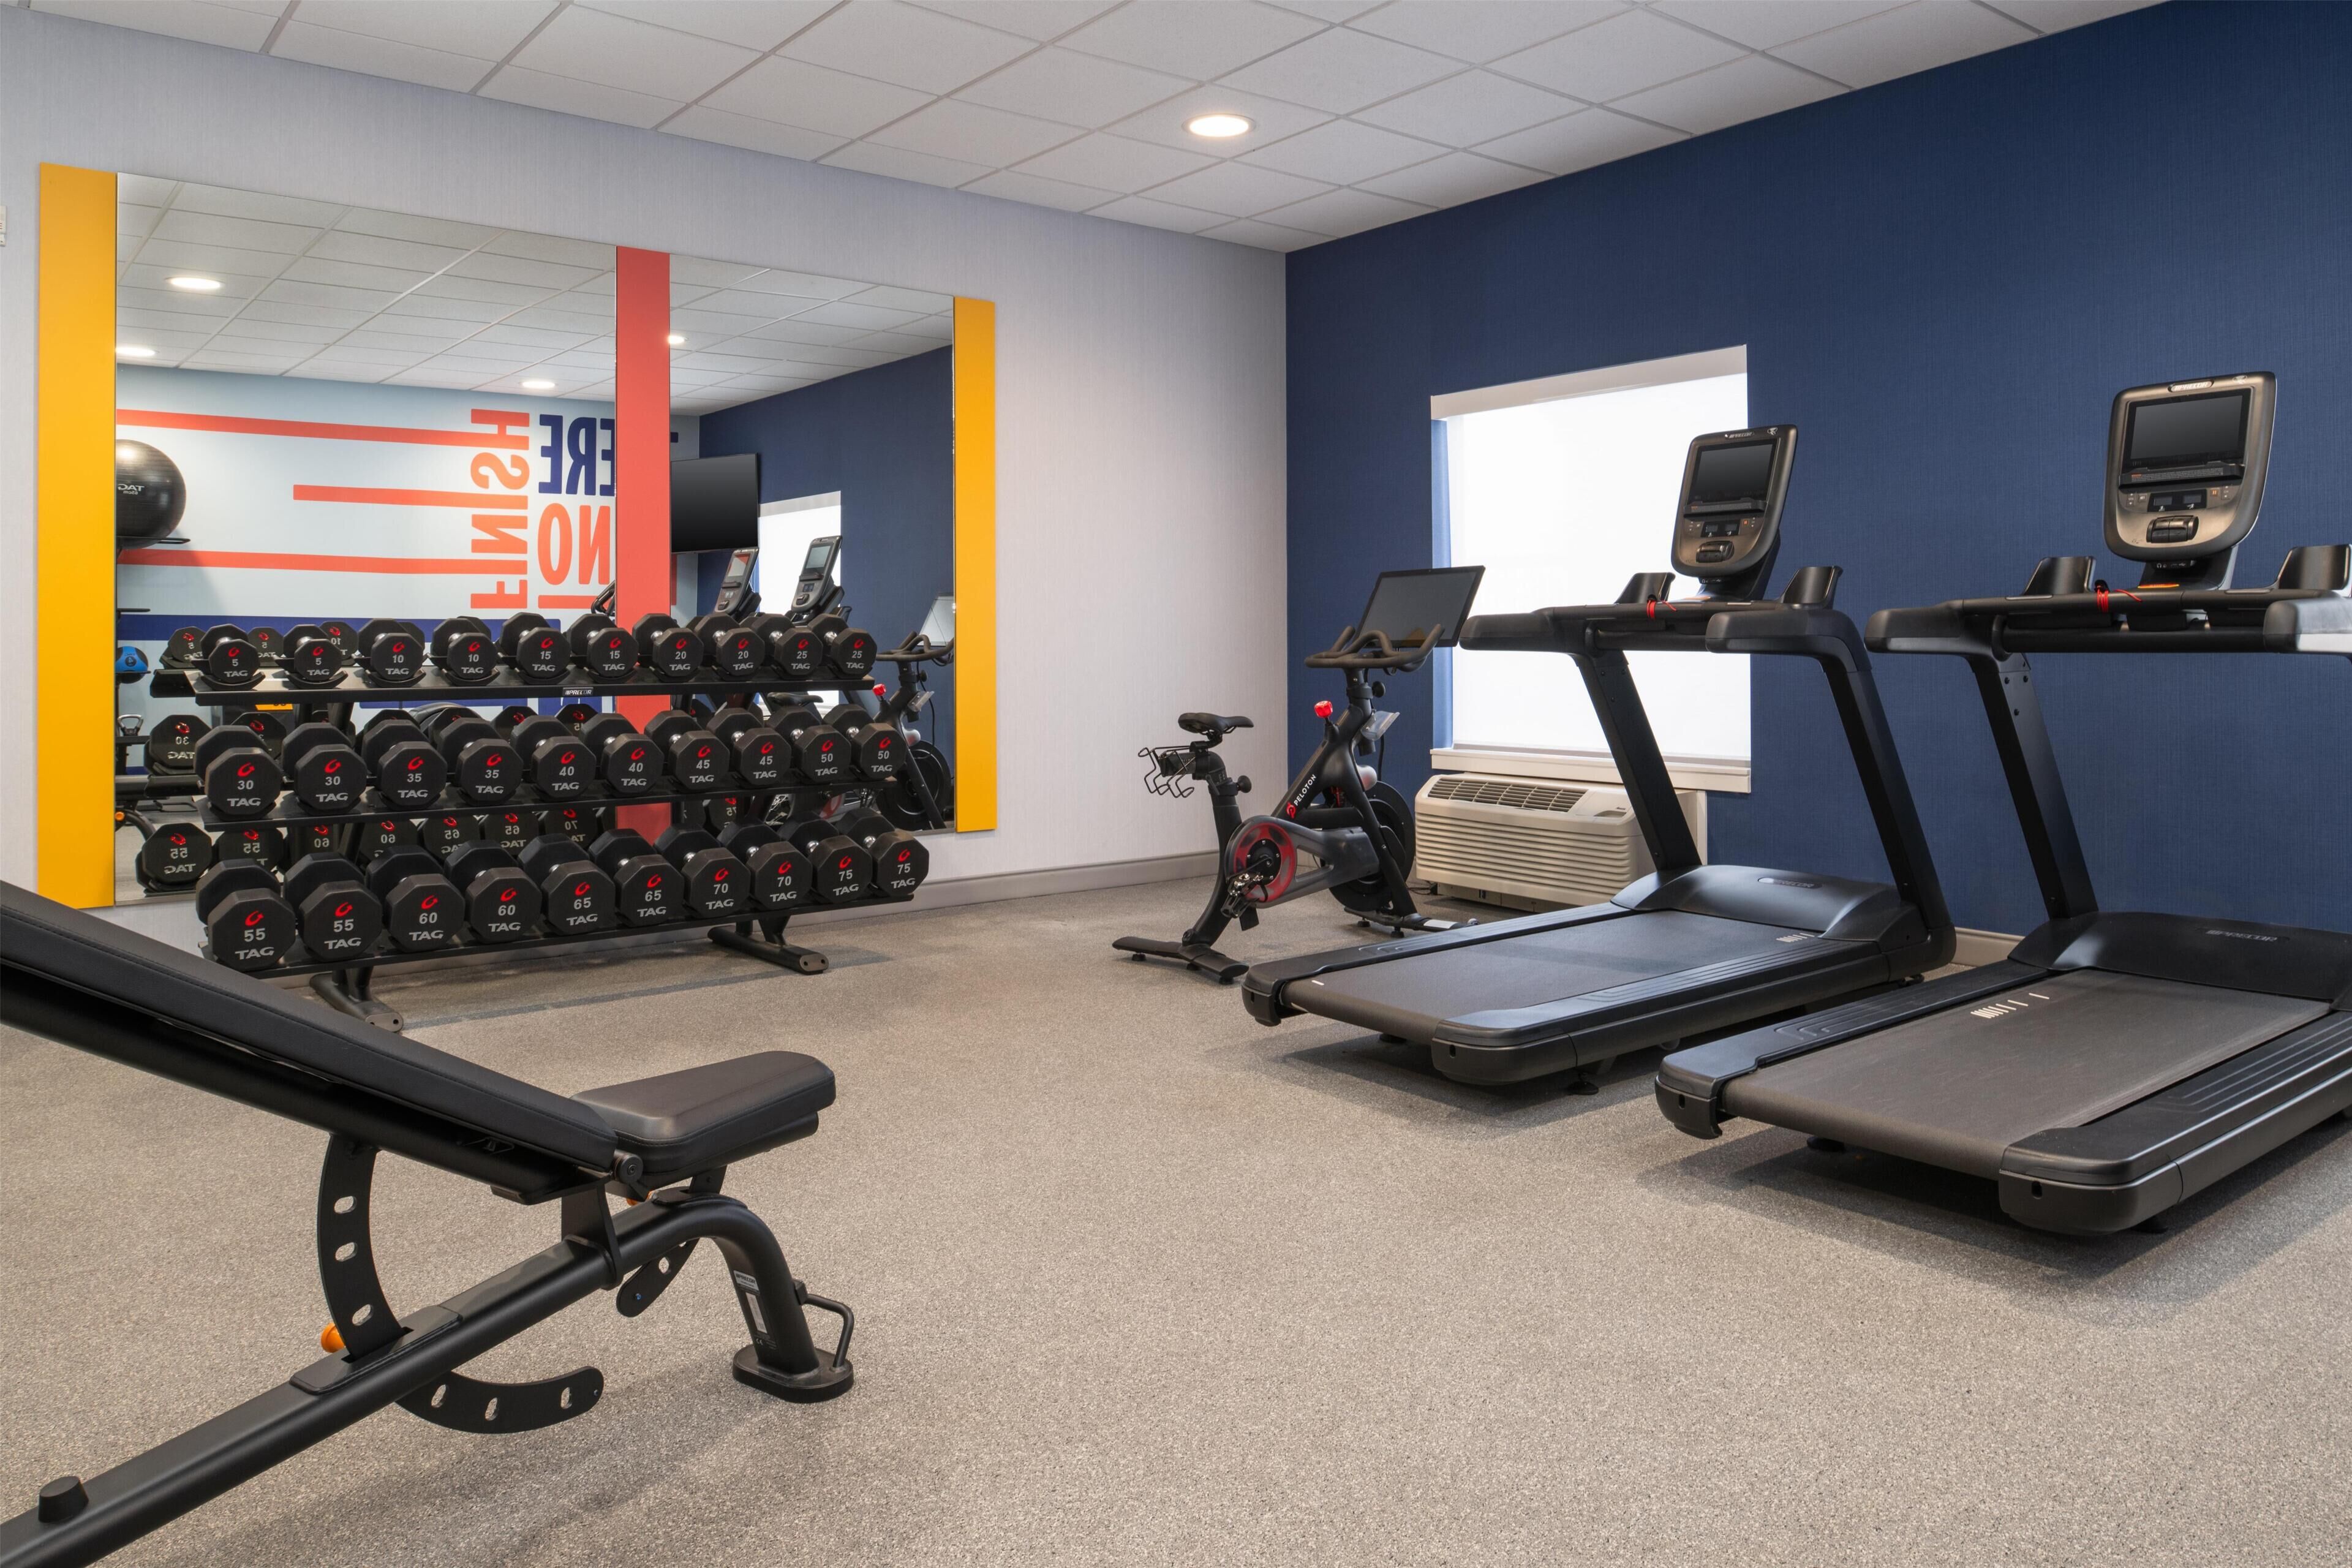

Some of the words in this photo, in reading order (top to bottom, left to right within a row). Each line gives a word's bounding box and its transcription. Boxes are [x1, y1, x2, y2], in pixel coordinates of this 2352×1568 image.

[541, 651, 551, 660] 15
[610, 650, 620, 659] 15
[738, 650, 748, 659] 20
[760, 756, 772, 765] 45
[821, 753, 833, 763] 50
[628, 763, 643, 772] 40
[696, 760, 710, 769] 45
[485, 770, 499, 778] 35
[559, 766, 574, 776] 40
[325, 776, 340, 785] 30
[407, 774, 421, 782] 35
[238, 780, 254, 790] 30
[1294, 774, 1316, 806] PELOTON
[316, 793, 348, 802] TAG
[898, 863, 910, 874] 75
[839, 870, 853, 881] 75
[777, 876, 791, 887] 70
[891, 878, 915, 889] TAG
[714, 883, 728, 894] 70
[833, 884, 859, 895] TAG
[645, 890, 662, 902] 65
[770, 891, 796, 902] TAG
[574, 897, 591, 910] 65
[706, 899, 734, 910] TAG
[498, 905, 515, 916] 60
[637, 907, 666, 917] TAG
[420, 913, 437, 924] 60
[567, 914, 597, 925] TAG
[334, 919, 353, 932] 55
[488, 922, 521, 932] TAG
[245, 928, 265, 941] 55
[409, 930, 443, 940] TAG
[324, 938, 361, 949] TAG
[235, 947, 274, 959] TAG
